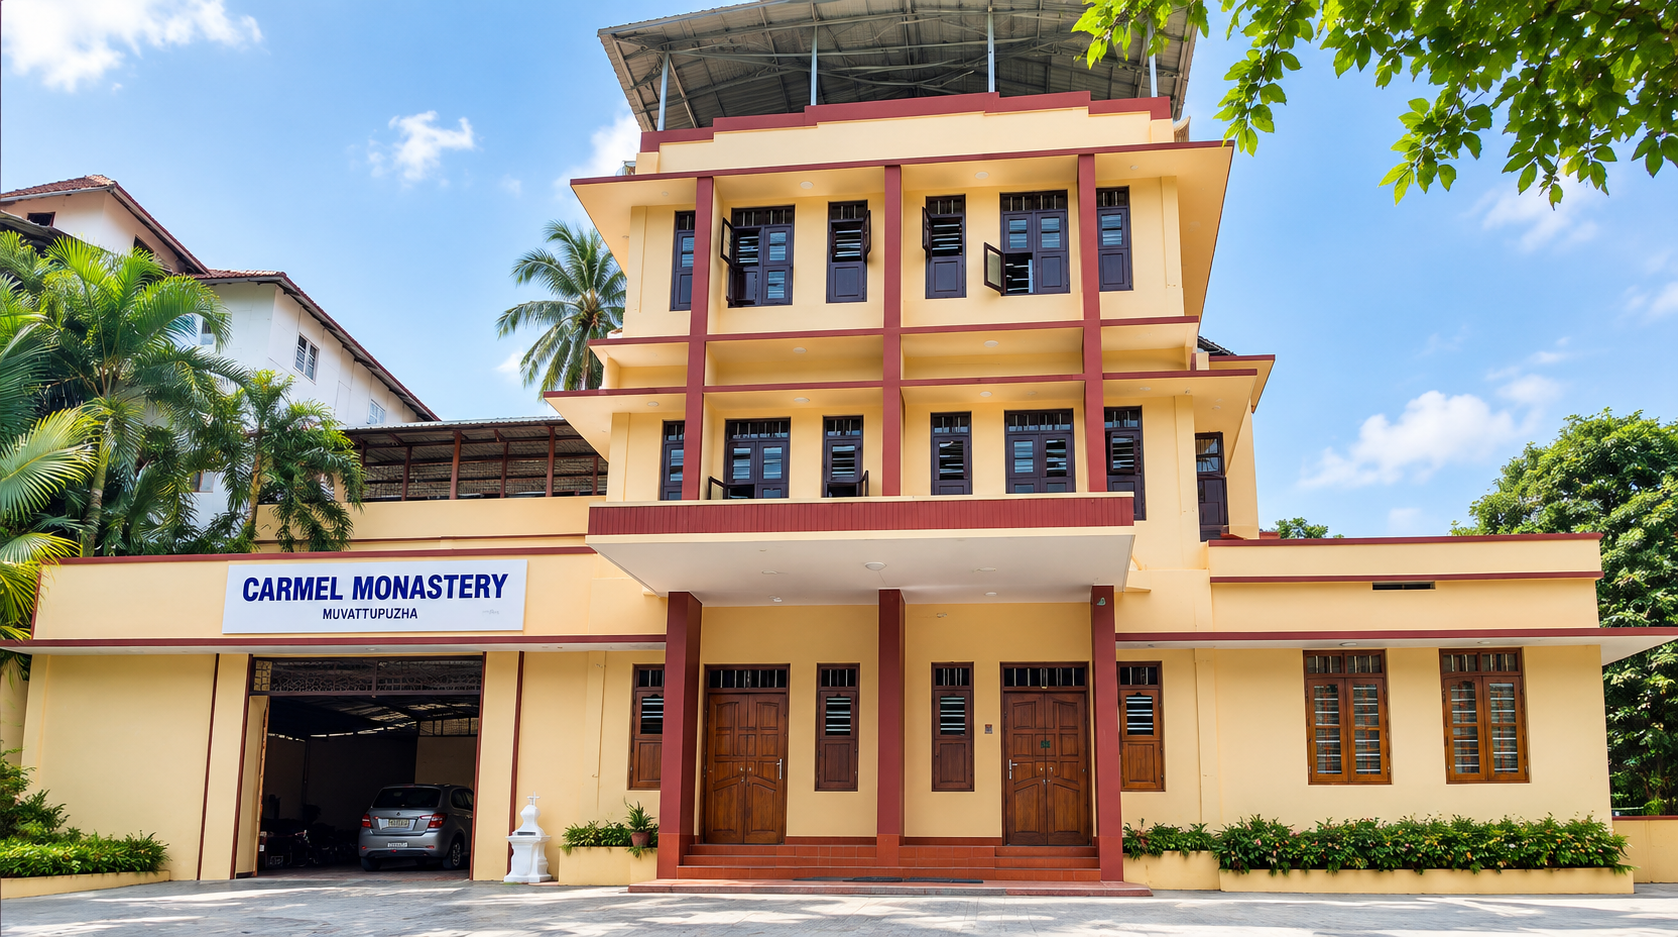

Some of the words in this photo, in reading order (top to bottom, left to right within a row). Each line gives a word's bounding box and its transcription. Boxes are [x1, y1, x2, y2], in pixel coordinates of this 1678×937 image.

[242, 576, 344, 602] CARMEL
[352, 573, 508, 601] MONASTERY
[322, 607, 418, 620] MUVATTUPUZHA
